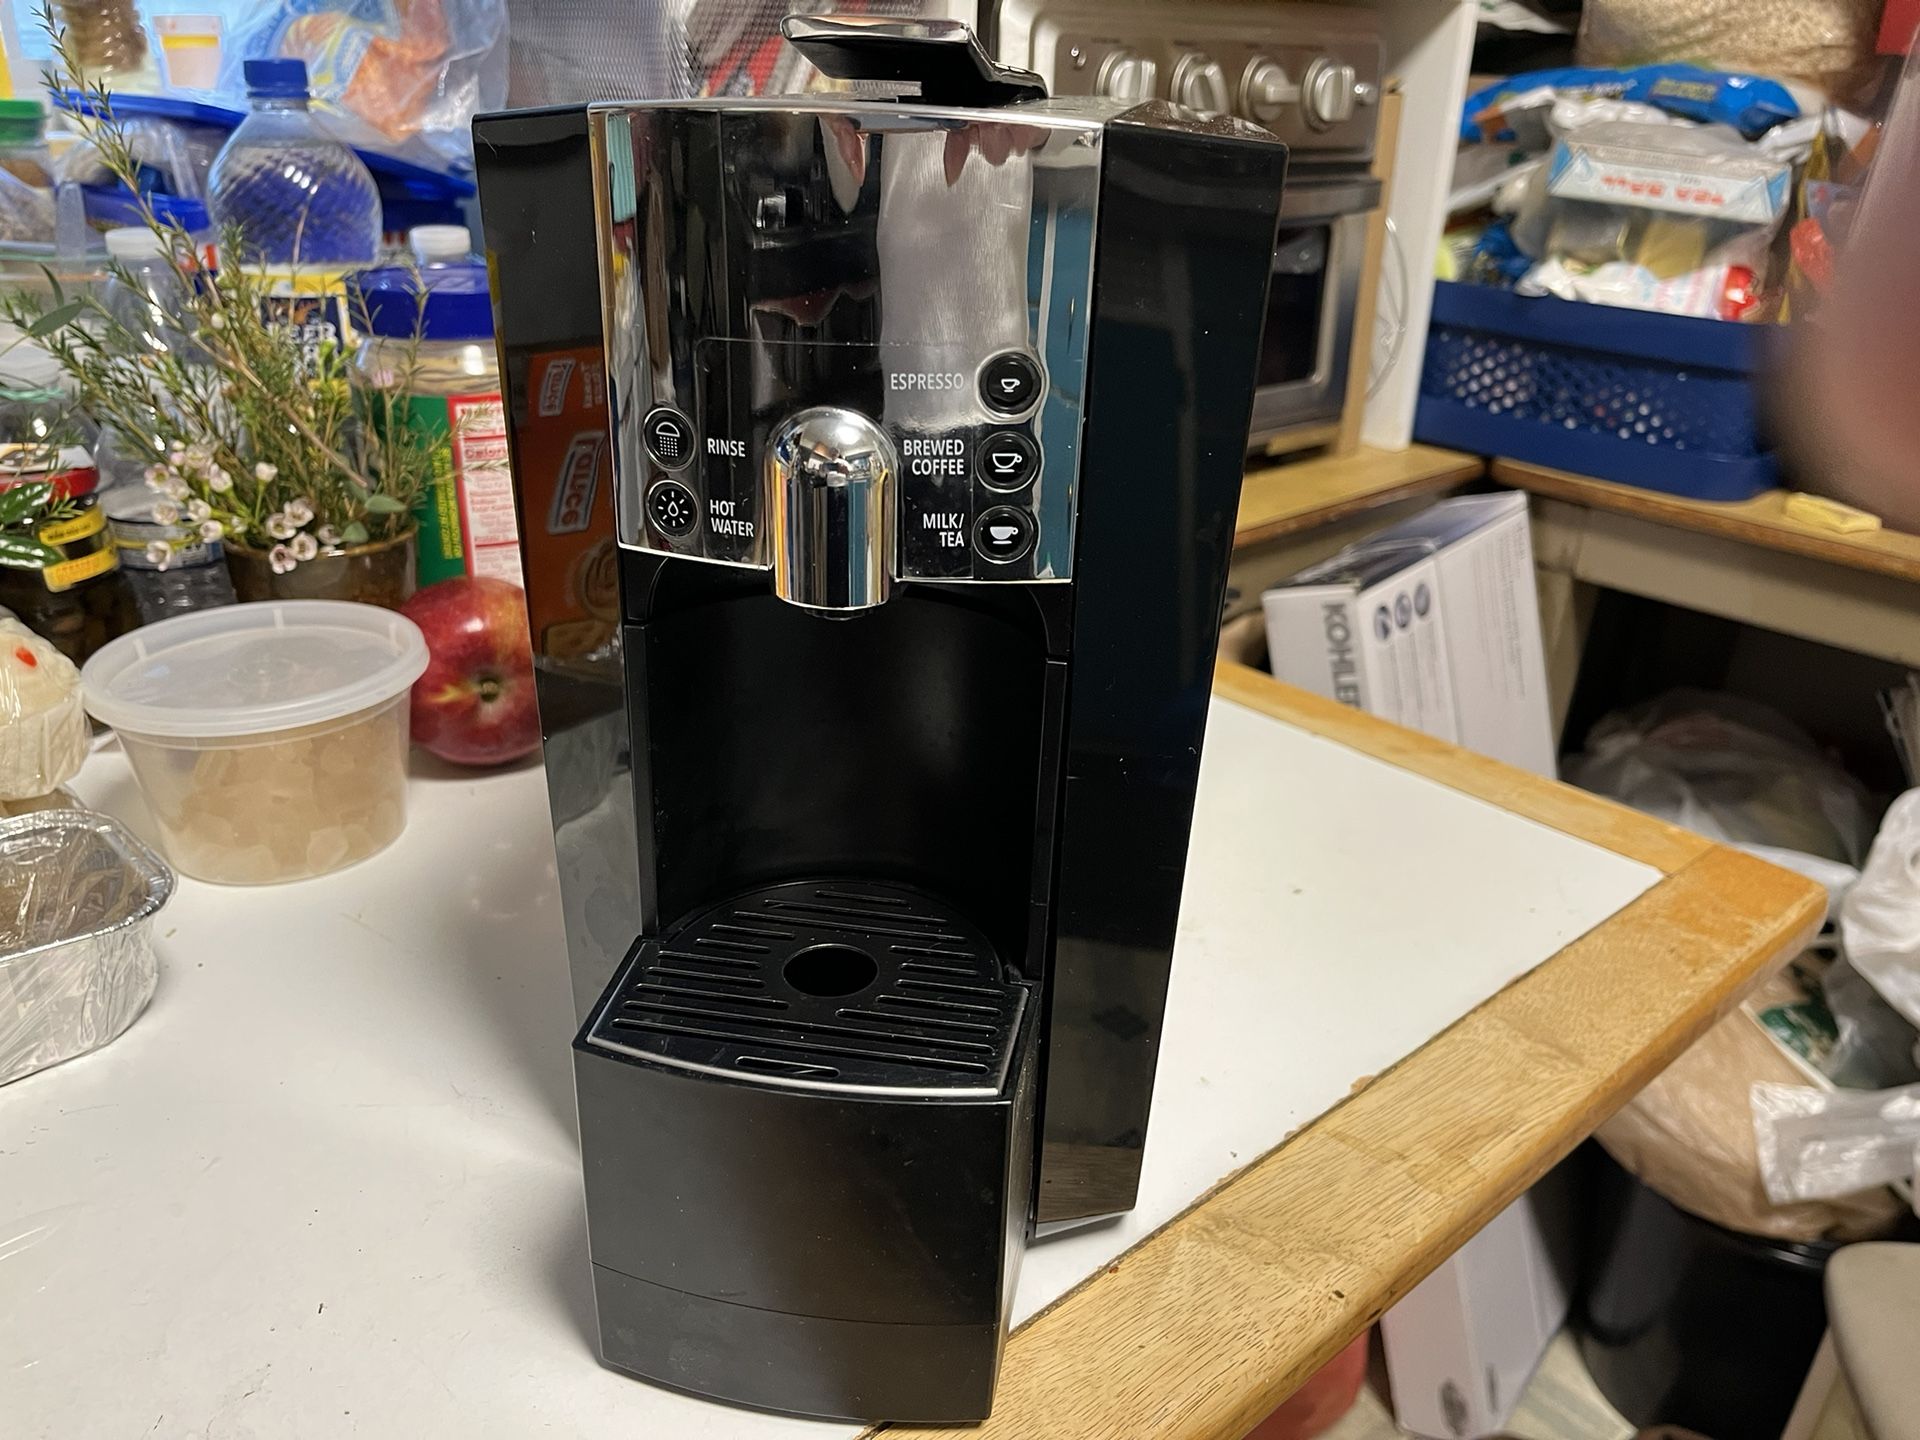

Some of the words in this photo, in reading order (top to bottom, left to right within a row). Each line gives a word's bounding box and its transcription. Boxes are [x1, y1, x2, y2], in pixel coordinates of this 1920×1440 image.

[890, 373, 965, 392] ESPRESSO
[706, 438, 747, 459] RINSE
[903, 439, 965, 457] BREWED
[911, 459, 965, 476] COFFEE
[709, 499, 736, 517] HOT
[710, 517, 755, 538] WATER
[922, 513, 965, 531] MILK/
[939, 530, 965, 548] TEA
